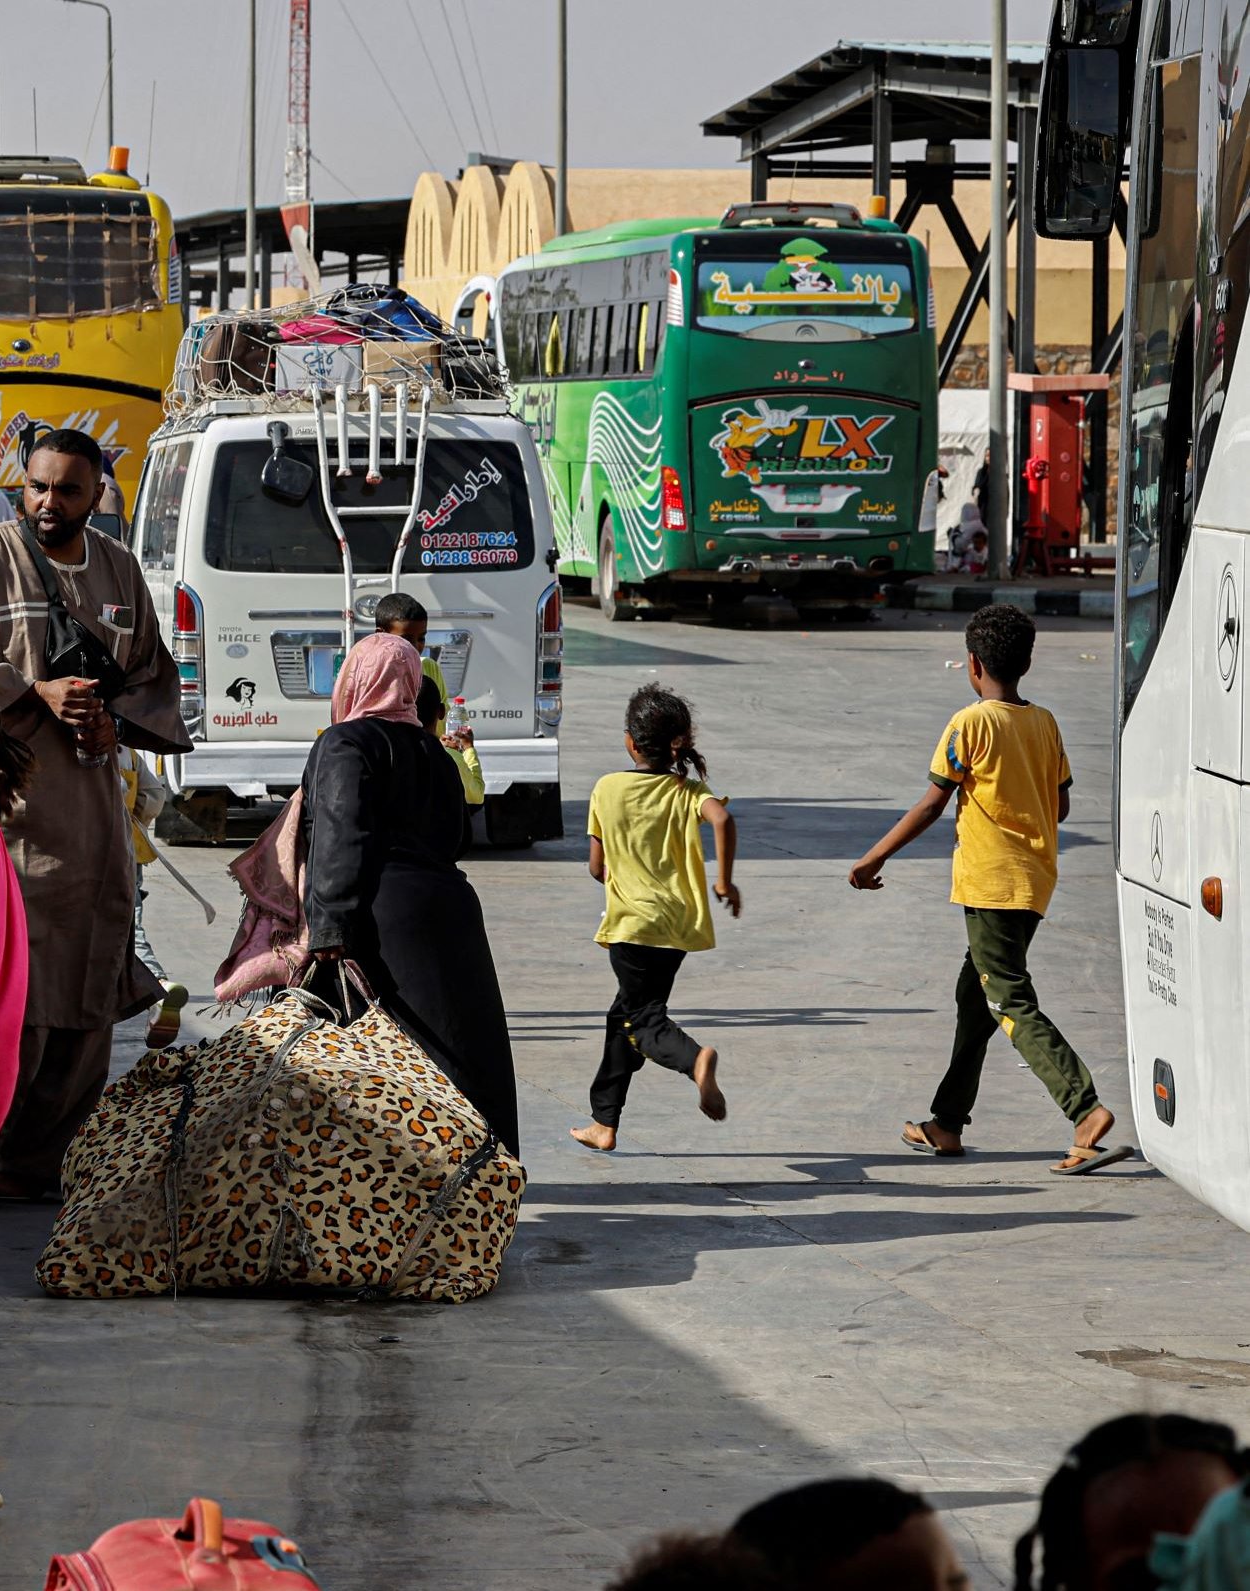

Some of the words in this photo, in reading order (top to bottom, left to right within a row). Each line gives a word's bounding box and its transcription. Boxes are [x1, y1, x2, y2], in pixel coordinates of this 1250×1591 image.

[421, 531, 517, 548] 0122187624
[421, 549, 518, 566] 0128896079
[217, 634, 261, 643] HIACE
[481, 710, 523, 719] TURBO
